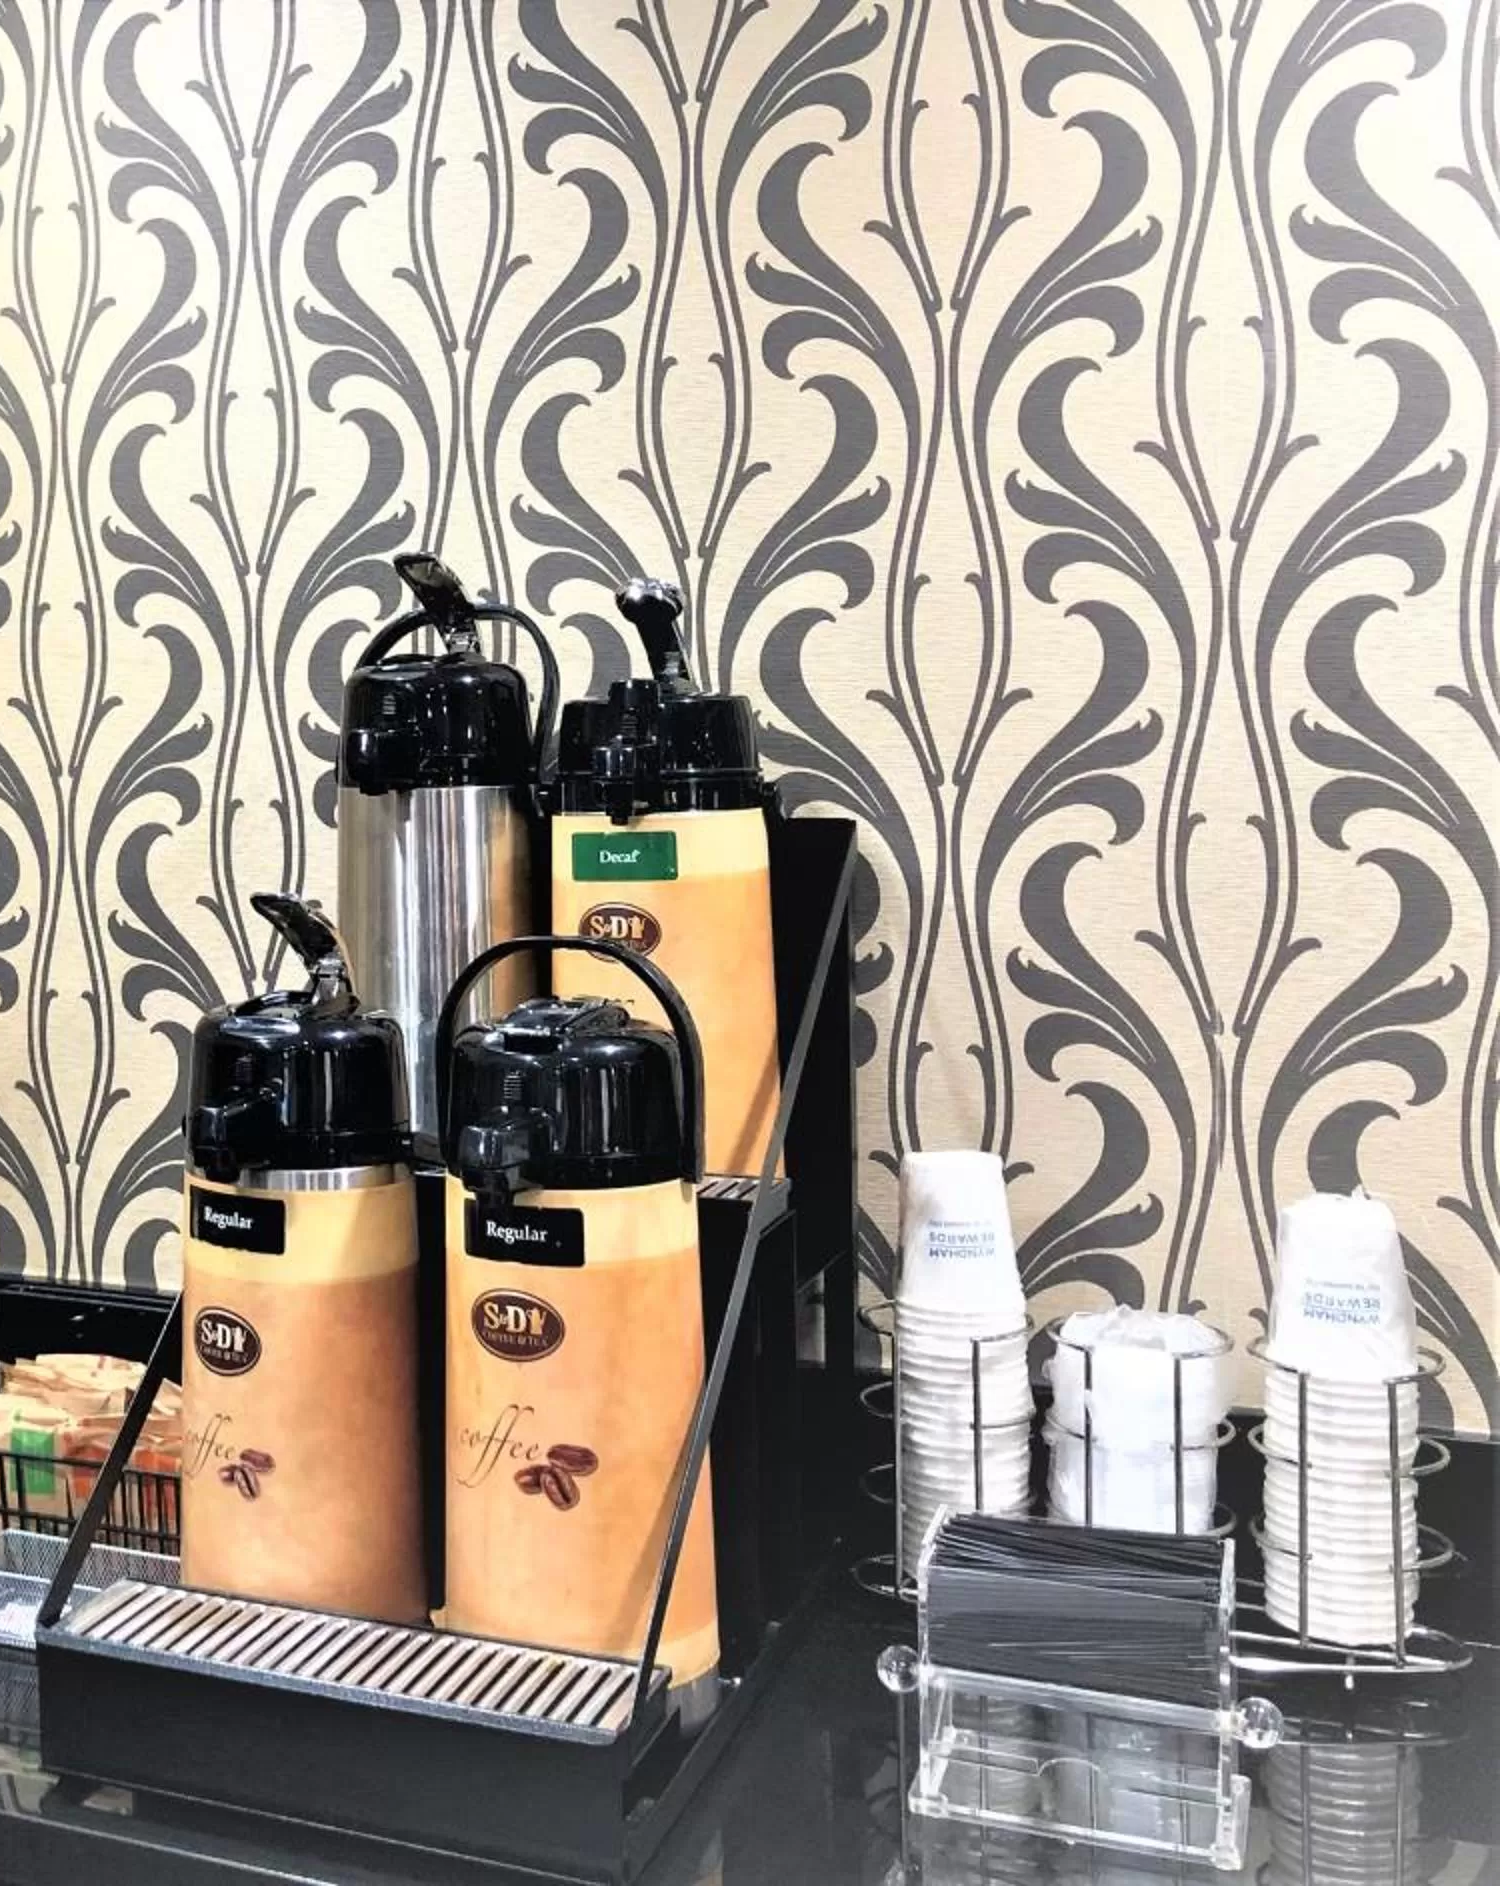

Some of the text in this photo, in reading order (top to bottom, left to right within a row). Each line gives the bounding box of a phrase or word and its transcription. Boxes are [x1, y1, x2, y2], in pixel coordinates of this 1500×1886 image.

[599, 849, 641, 863] Decaf
[203, 1205, 254, 1229] Regular
[485, 1219, 548, 1245] Regular
[929, 1246, 995, 1259] WYNDHAM
[1303, 1307, 1381, 1325] WYNDHAM
[455, 1404, 540, 1488] coffee
